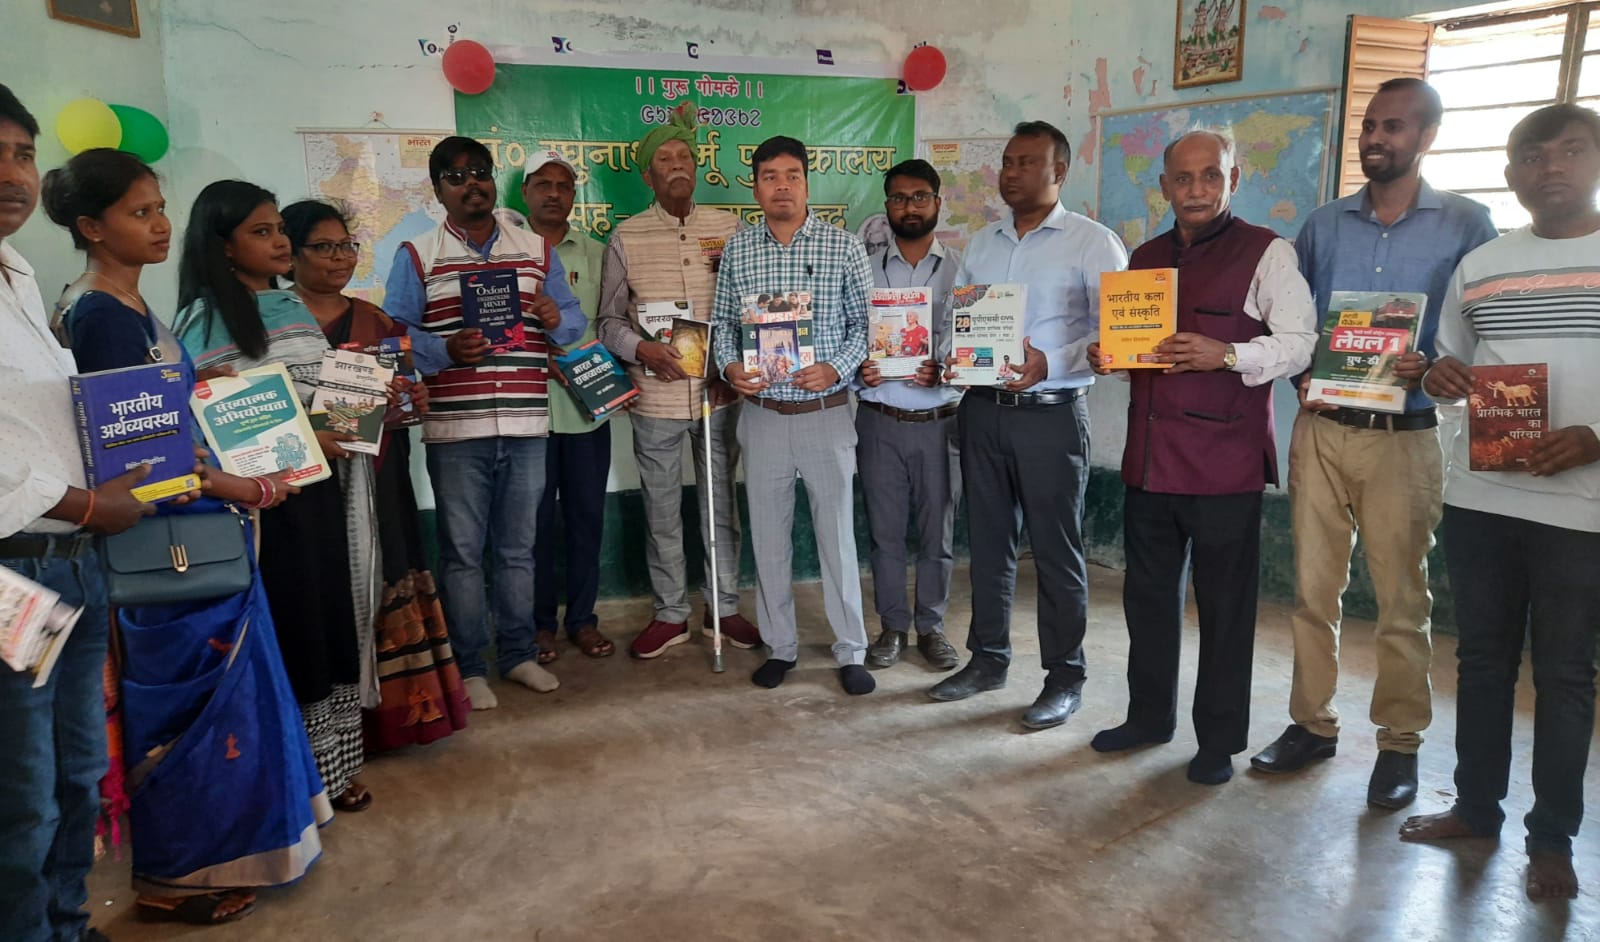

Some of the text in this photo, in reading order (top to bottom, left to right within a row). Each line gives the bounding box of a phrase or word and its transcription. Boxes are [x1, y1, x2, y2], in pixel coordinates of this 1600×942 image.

[695, 74, 739, 97] गोमके
[476, 284, 511, 297] Oxford
[1107, 291, 1164, 303] भारतीय कला
[1112, 305, 1161, 320] एवं संस्कृति
[956, 316, 971, 329] 28
[1335, 330, 1400, 352] लेवल 1
[335, 361, 375, 375] झारखण्ड
[572, 360, 593, 375] भारत
[1346, 355, 1380, 367] ग्रुप-डी
[573, 361, 614, 386] राजव्यवस्था
[109, 391, 164, 416] भारतीय
[213, 390, 278, 413] संख्यात्मक
[213, 400, 288, 427] अभियोग्यता
[1516, 408, 1542, 417] भारत
[101, 411, 180, 439] अर्थव्यवस्था
[1528, 419, 1541, 428] का
